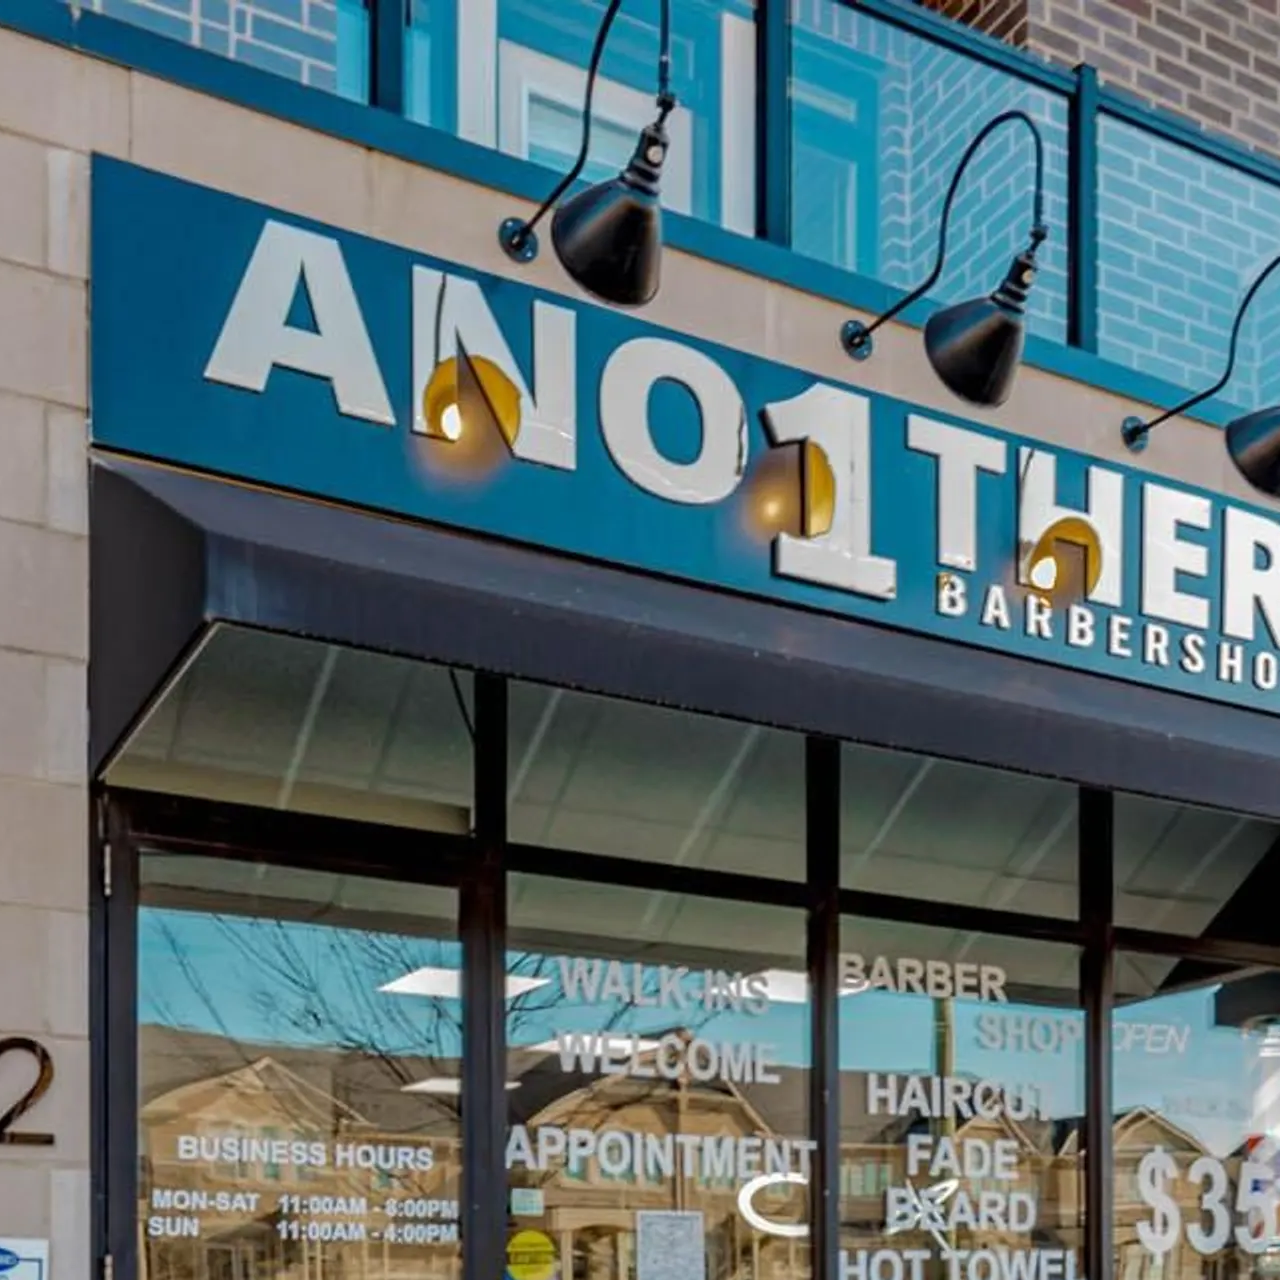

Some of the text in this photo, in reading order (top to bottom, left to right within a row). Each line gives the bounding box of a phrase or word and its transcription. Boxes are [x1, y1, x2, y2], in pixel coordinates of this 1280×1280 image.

[557, 956, 770, 1015] WALK-INS
[837, 953, 1008, 1004] BARBER
[978, 1012, 1083, 1053] SHOP
[555, 1029, 781, 1084] WELCOME
[867, 1072, 1051, 1122] HAIRCUT
[177, 1135, 434, 1171] BUSINESS HOURS
[504, 1124, 818, 1180] APPOINTMENT
[907, 1134, 1019, 1180] FADE
[152, 1189, 261, 1212] MON-SAT
[278, 1195, 367, 1215] 11:00AM
[886, 1186, 1037, 1233] BEARD
[147, 1216, 199, 1237] SUN
[277, 1220, 366, 1241] 11:00AM
[384, 1222, 459, 1243] 4:00PM
